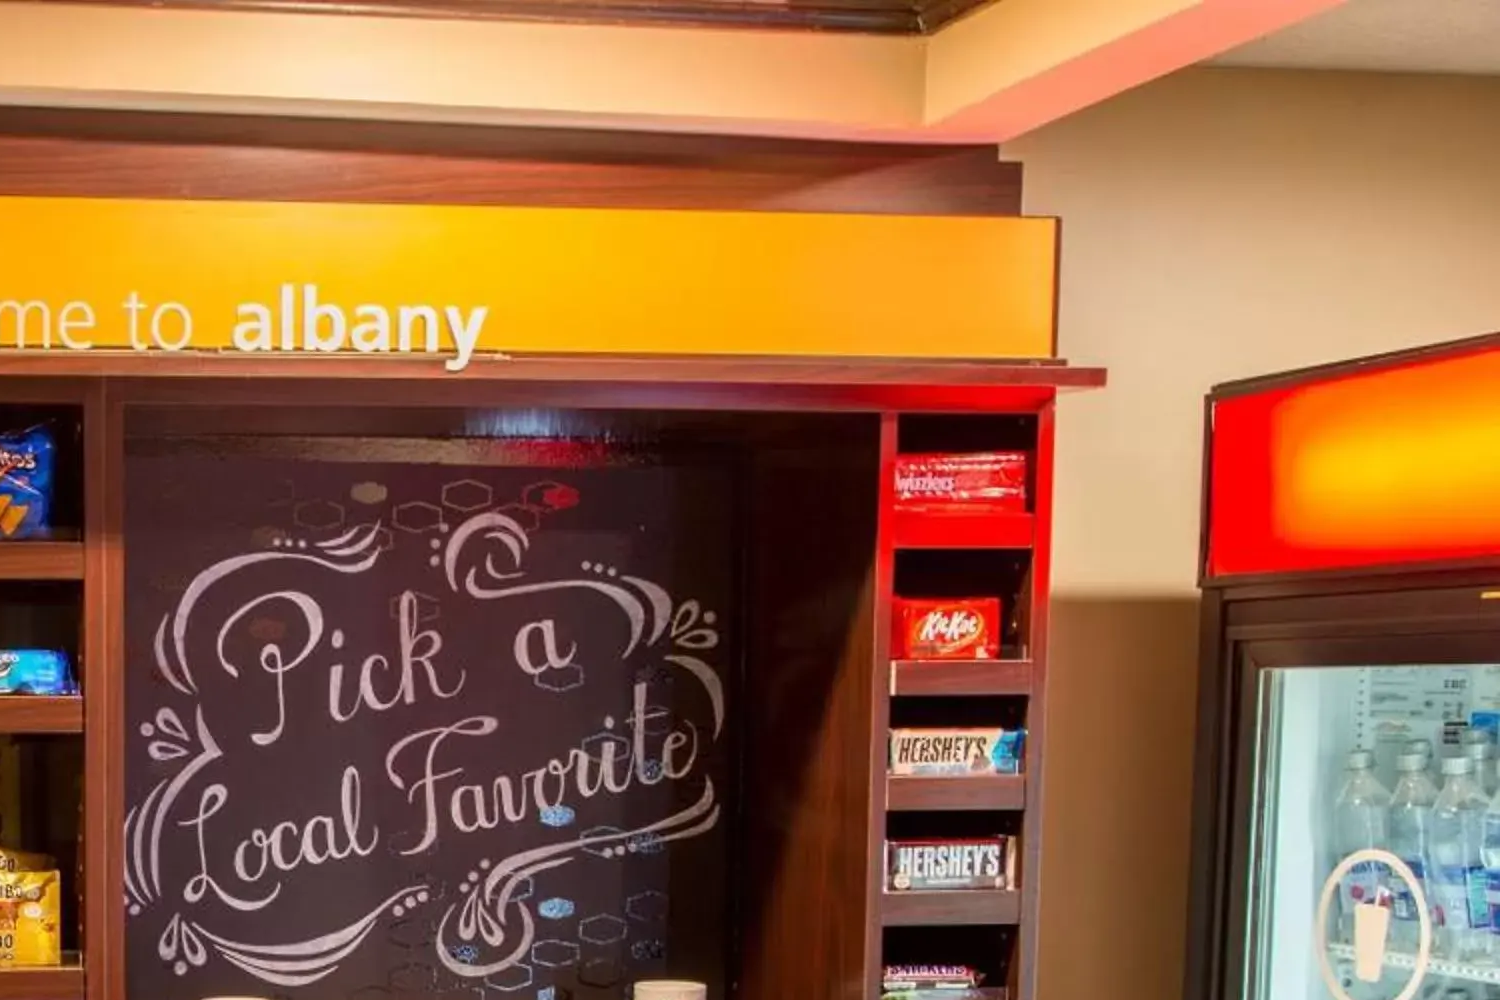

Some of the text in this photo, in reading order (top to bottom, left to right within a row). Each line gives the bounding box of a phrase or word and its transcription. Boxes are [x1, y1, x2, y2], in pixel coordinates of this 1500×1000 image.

[124, 290, 194, 351] to
[233, 283, 488, 372] albany
[216, 589, 577, 745] Pick a
[899, 735, 988, 764] HERSHEY'S
[178, 679, 697, 911] Local Favorite
[899, 844, 1000, 877] HERSHEY'S
